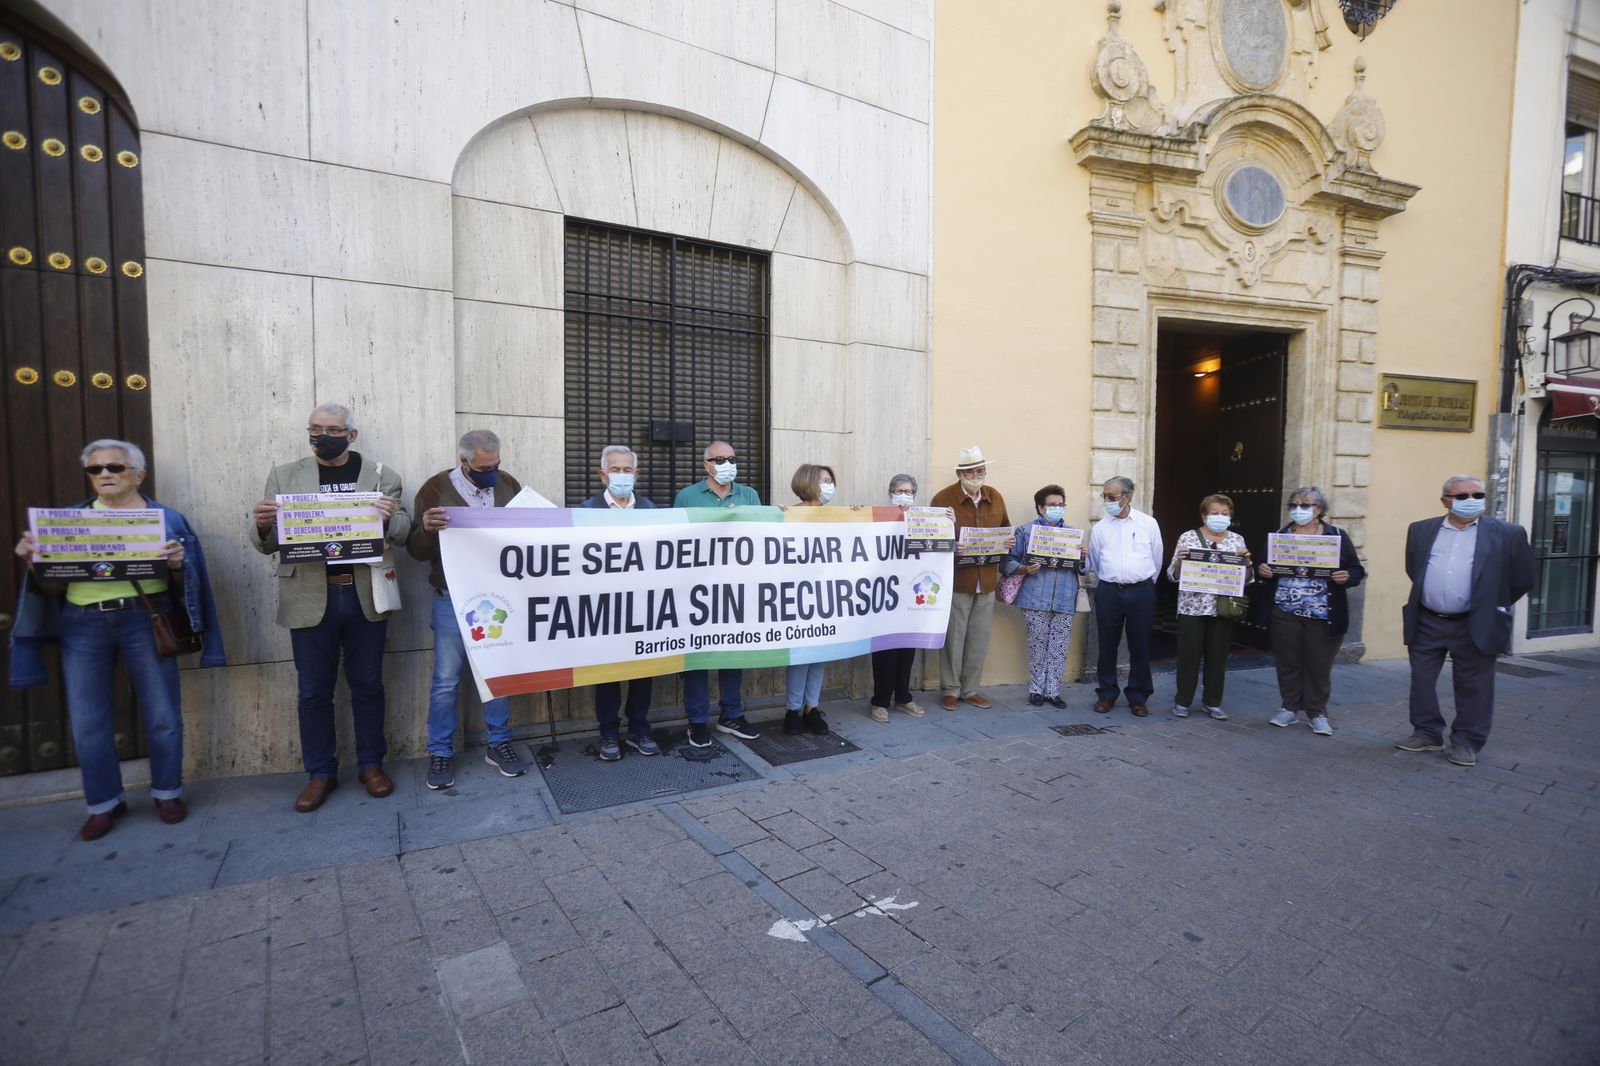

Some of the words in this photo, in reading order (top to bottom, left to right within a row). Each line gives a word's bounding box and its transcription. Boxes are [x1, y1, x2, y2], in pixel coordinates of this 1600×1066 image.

[500, 544, 570, 580] QUE
[582, 541, 644, 575] SEA
[655, 536, 760, 570] DELITO
[764, 536, 842, 565] DEJAR
[851, 536, 869, 562] A
[527, 588, 679, 642] FAMILIA
[689, 584, 745, 626] SIN
[758, 575, 899, 623] RECURSOS
[635, 636, 686, 655] Barrios
[690, 630, 760, 650] Ignorados
[766, 627, 782, 642] de
[786, 623, 836, 641] Córdoba
